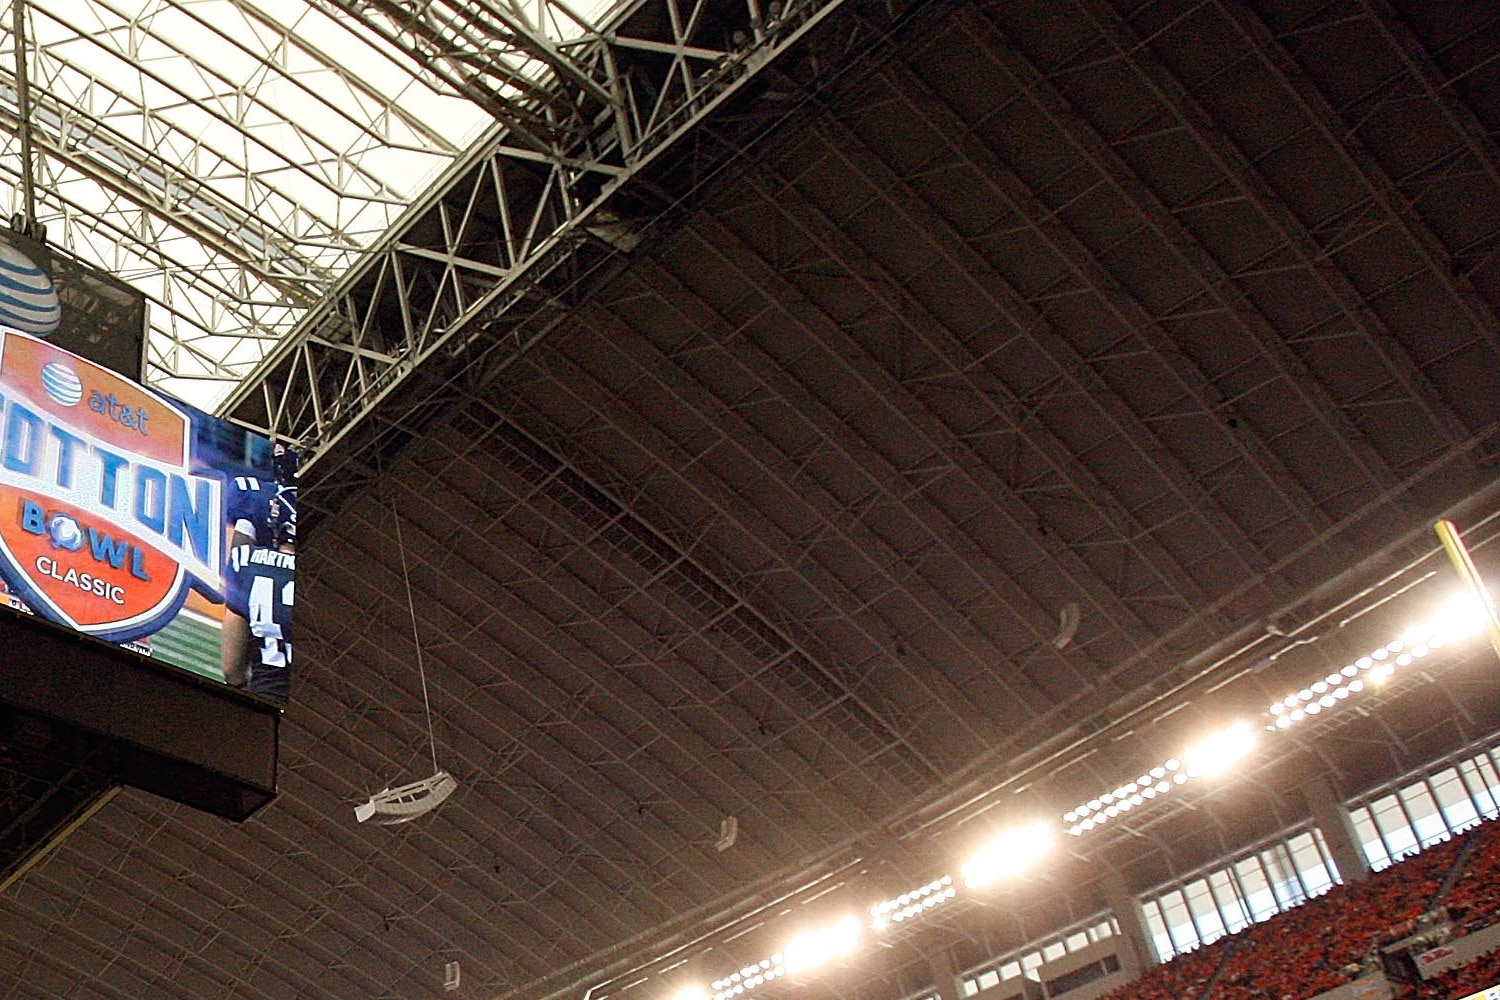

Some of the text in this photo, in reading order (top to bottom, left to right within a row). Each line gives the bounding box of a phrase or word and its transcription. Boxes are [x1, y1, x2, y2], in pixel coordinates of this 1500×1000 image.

[88, 386, 149, 437] at&t
[20, 498, 152, 582] BOWL
[35, 556, 126, 606] CLASSIC
